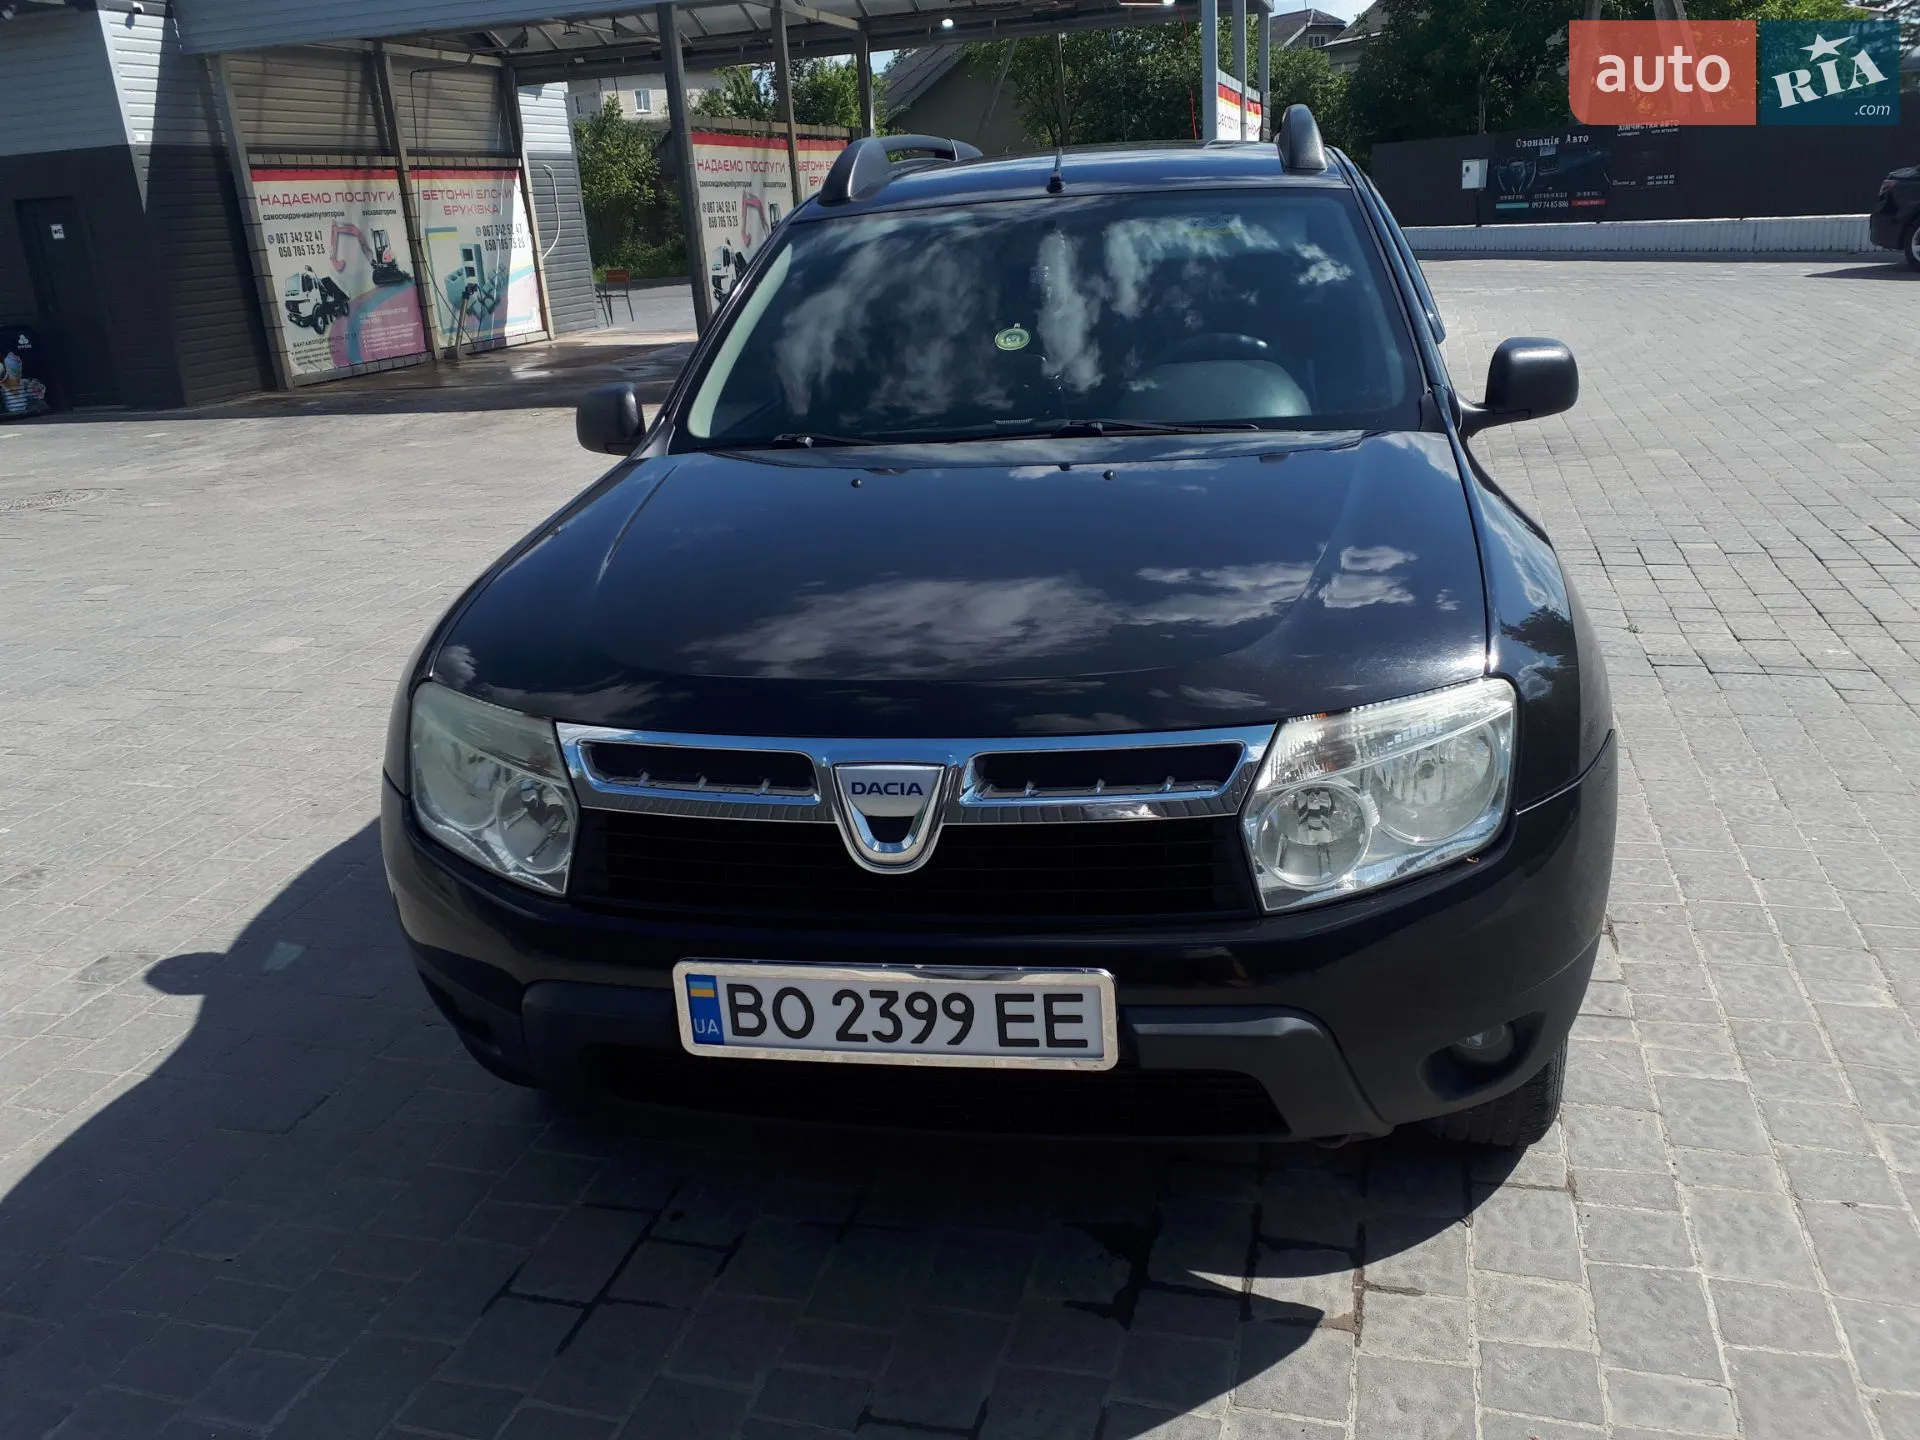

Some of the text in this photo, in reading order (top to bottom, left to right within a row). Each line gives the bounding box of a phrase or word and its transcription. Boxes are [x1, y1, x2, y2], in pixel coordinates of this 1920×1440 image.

[1515, 134, 1590, 148] Озонація Авто
[696, 159, 786, 173] НАДАЄМО ПОСЛУГИ
[260, 191, 396, 206] НАДАЄМО ПОСЛУГИ
[422, 189, 474, 200] БЕТОННІ
[443, 204, 500, 216] БРУКІВКА
[276, 230, 323, 244] 067 342 52 47
[482, 225, 494, 237] 067
[494, 224, 506, 235] 342
[279, 244, 326, 257] 050 705 75 25
[851, 782, 924, 796] DACIA
[726, 983, 1089, 1048] BO 2399 EE
[693, 1018, 720, 1036] UA
